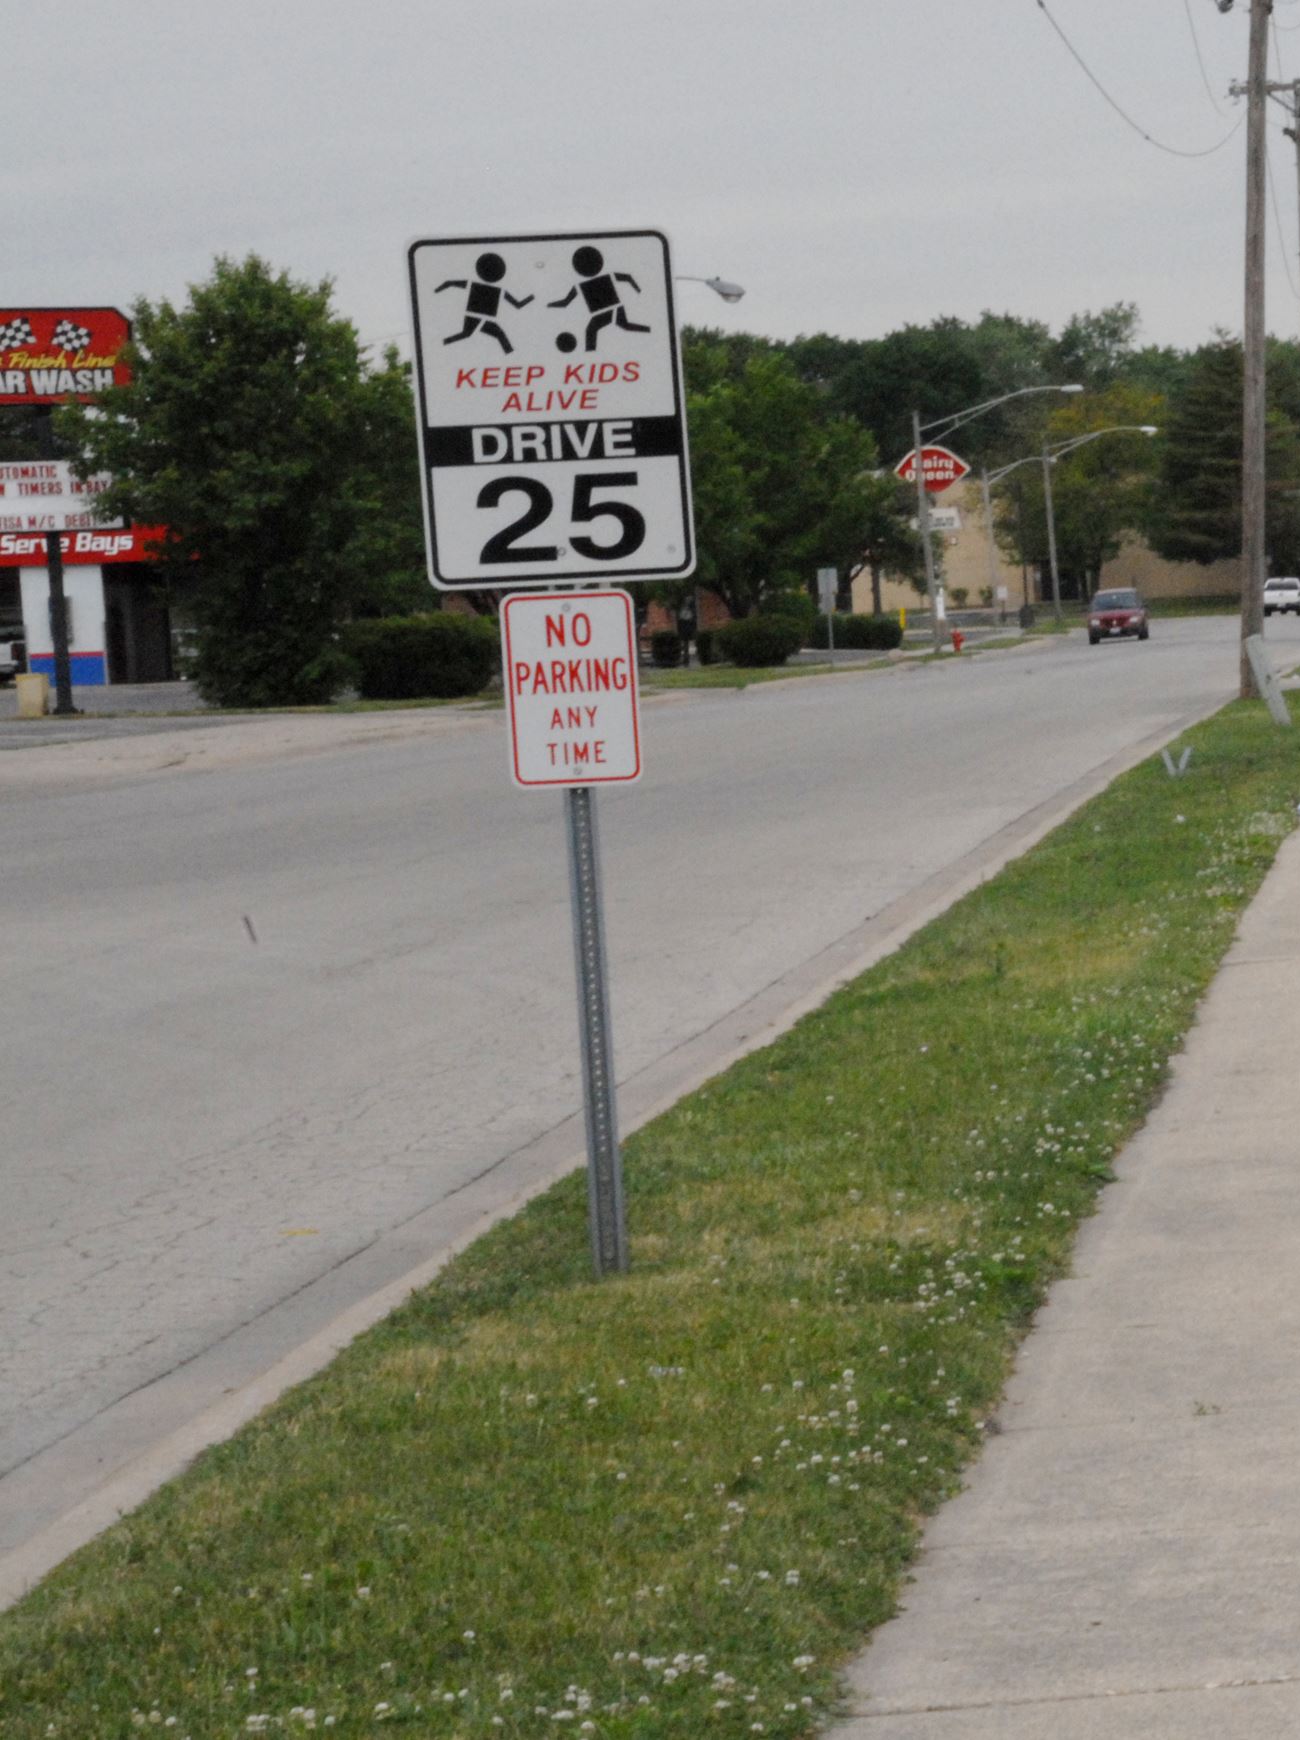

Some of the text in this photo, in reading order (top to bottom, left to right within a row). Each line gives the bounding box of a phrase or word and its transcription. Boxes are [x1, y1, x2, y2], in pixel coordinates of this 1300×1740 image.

[9, 351, 66, 368] Finish
[30, 369, 114, 395] WASH
[456, 361, 641, 388] KEEP KIDS
[501, 389, 600, 413] ALIVE
[471, 420, 636, 464] DRIVE
[18, 482, 62, 496] TIMERS
[0, 516, 22, 530] ISA
[476, 471, 646, 565] 25
[75, 532, 133, 555] Bays
[545, 612, 592, 648] NO
[515, 657, 627, 695] PARKING
[550, 705, 598, 730] ANY
[546, 741, 606, 766] TIME
